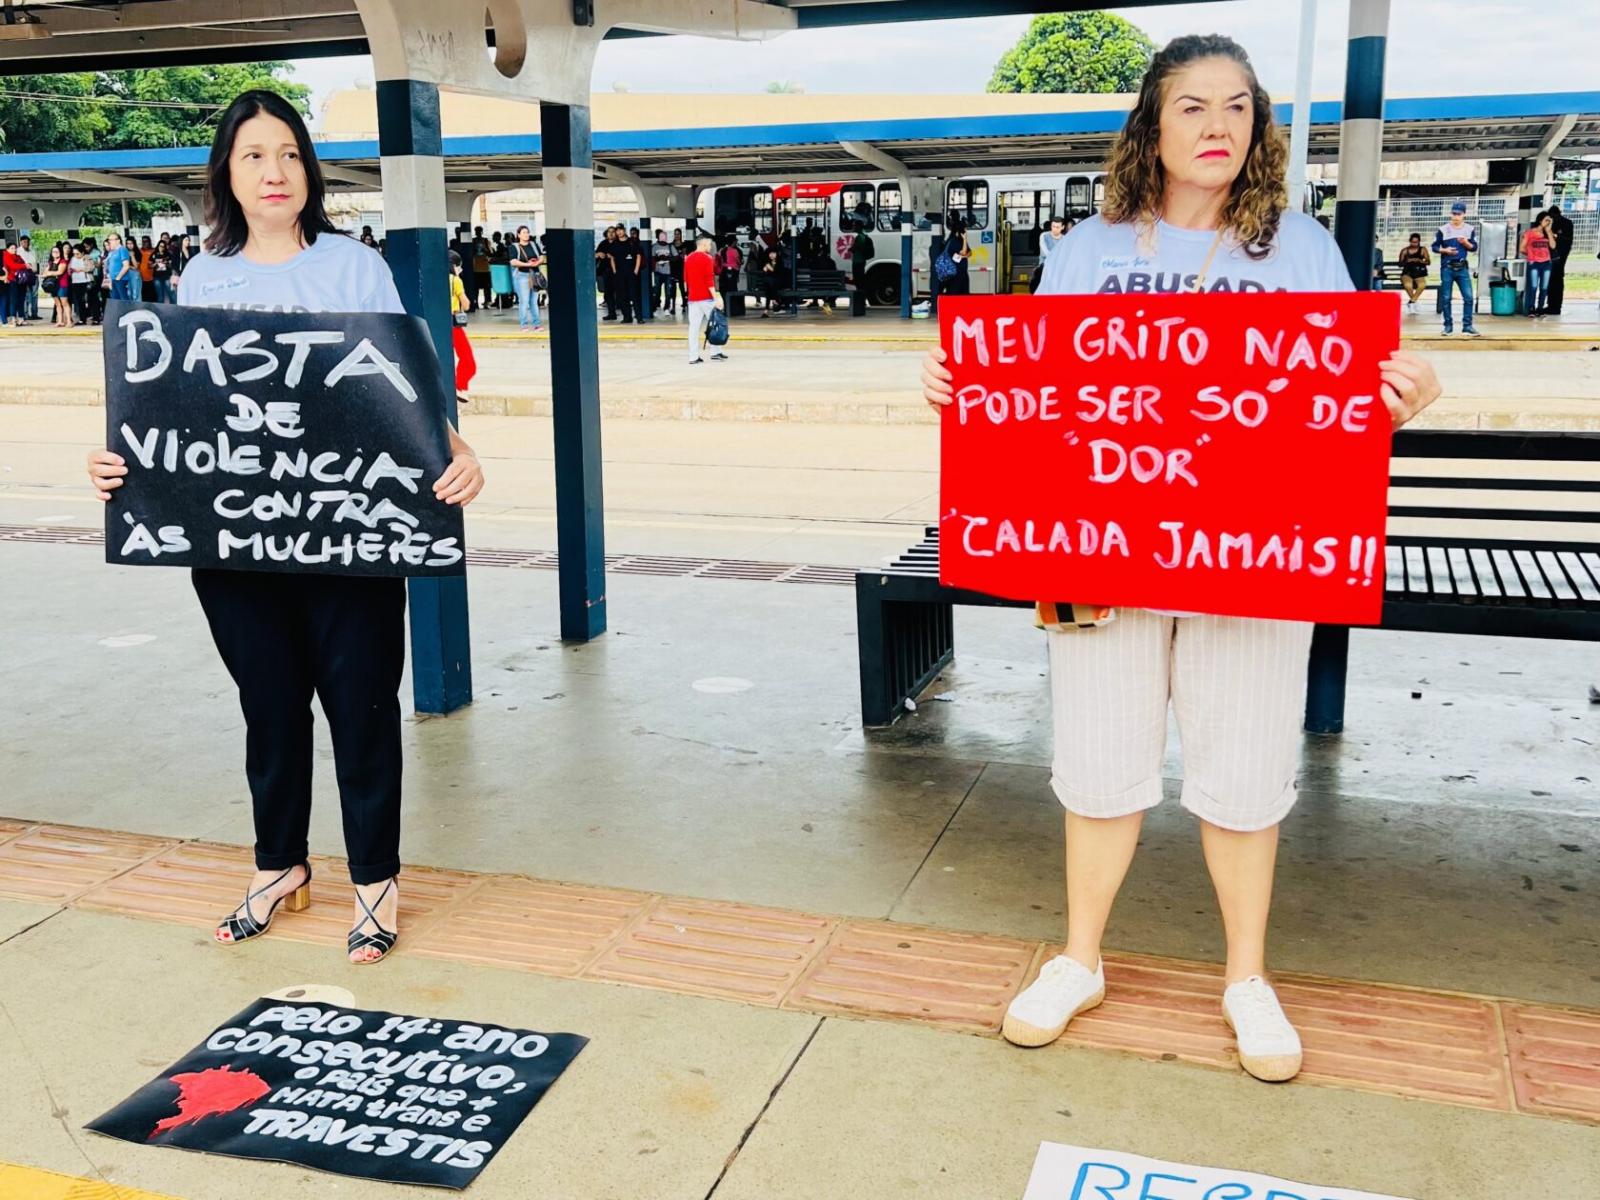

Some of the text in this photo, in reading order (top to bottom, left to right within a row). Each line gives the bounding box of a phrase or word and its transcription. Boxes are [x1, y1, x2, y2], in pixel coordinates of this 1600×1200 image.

[1096, 272, 1287, 294] ABUSAD
[119, 309, 417, 402] BASTA
[953, 316, 1045, 366] MEU
[1245, 311, 1352, 375] NÃO
[224, 394, 304, 438] DE
[956, 378, 1373, 432] PODE SER SÓ DE
[214, 490, 419, 528] CONTRA
[121, 512, 463, 566] ÀS MULHERES
[443, 1024, 550, 1058] ano
[269, 1086, 492, 1132] MATA trans e
[396, 1084, 467, 1107] que
[243, 1108, 493, 1168] TRAVESTIS
